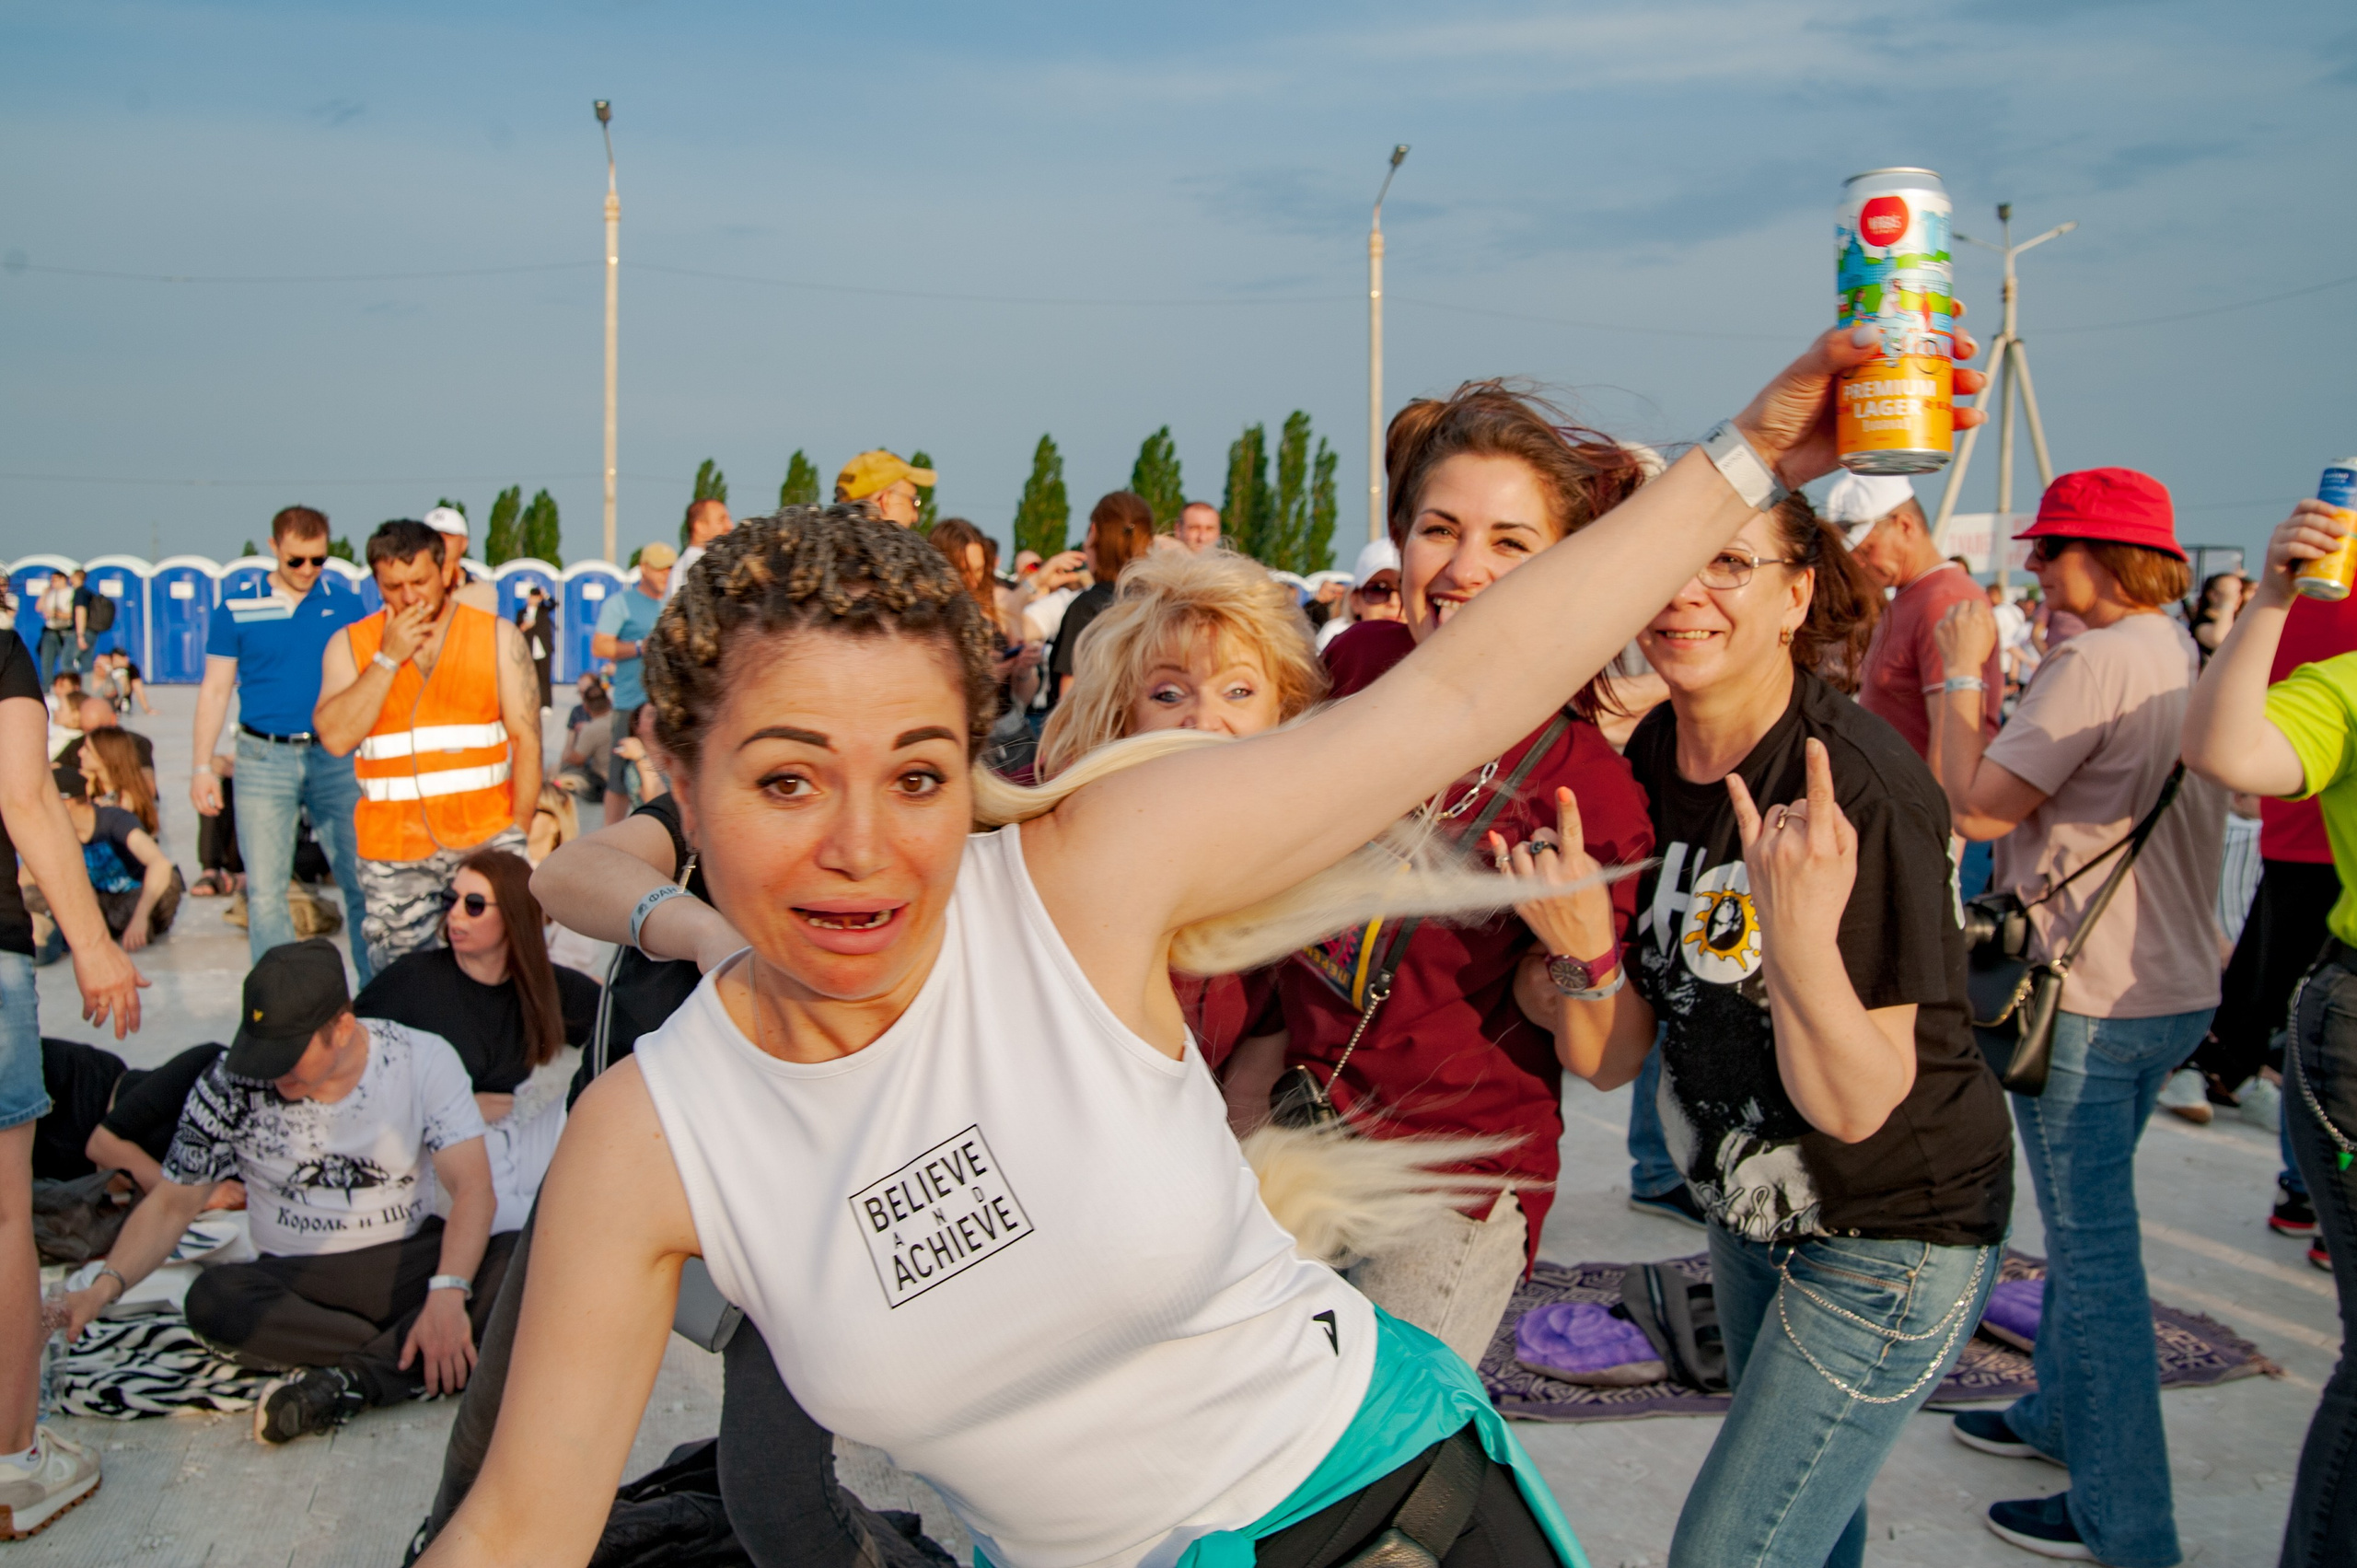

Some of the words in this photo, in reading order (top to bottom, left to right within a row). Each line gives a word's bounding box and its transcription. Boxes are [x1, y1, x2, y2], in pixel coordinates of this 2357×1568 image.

[1844, 379, 1936, 401] PREMIUM
[1853, 399, 1922, 418] LAGER
[864, 1141, 987, 1233] BELIEVE
[277, 1206, 347, 1234] Король
[359, 1218, 372, 1228] и
[382, 1199, 423, 1224] Шут
[893, 1195, 1019, 1292] ACHIEVE
